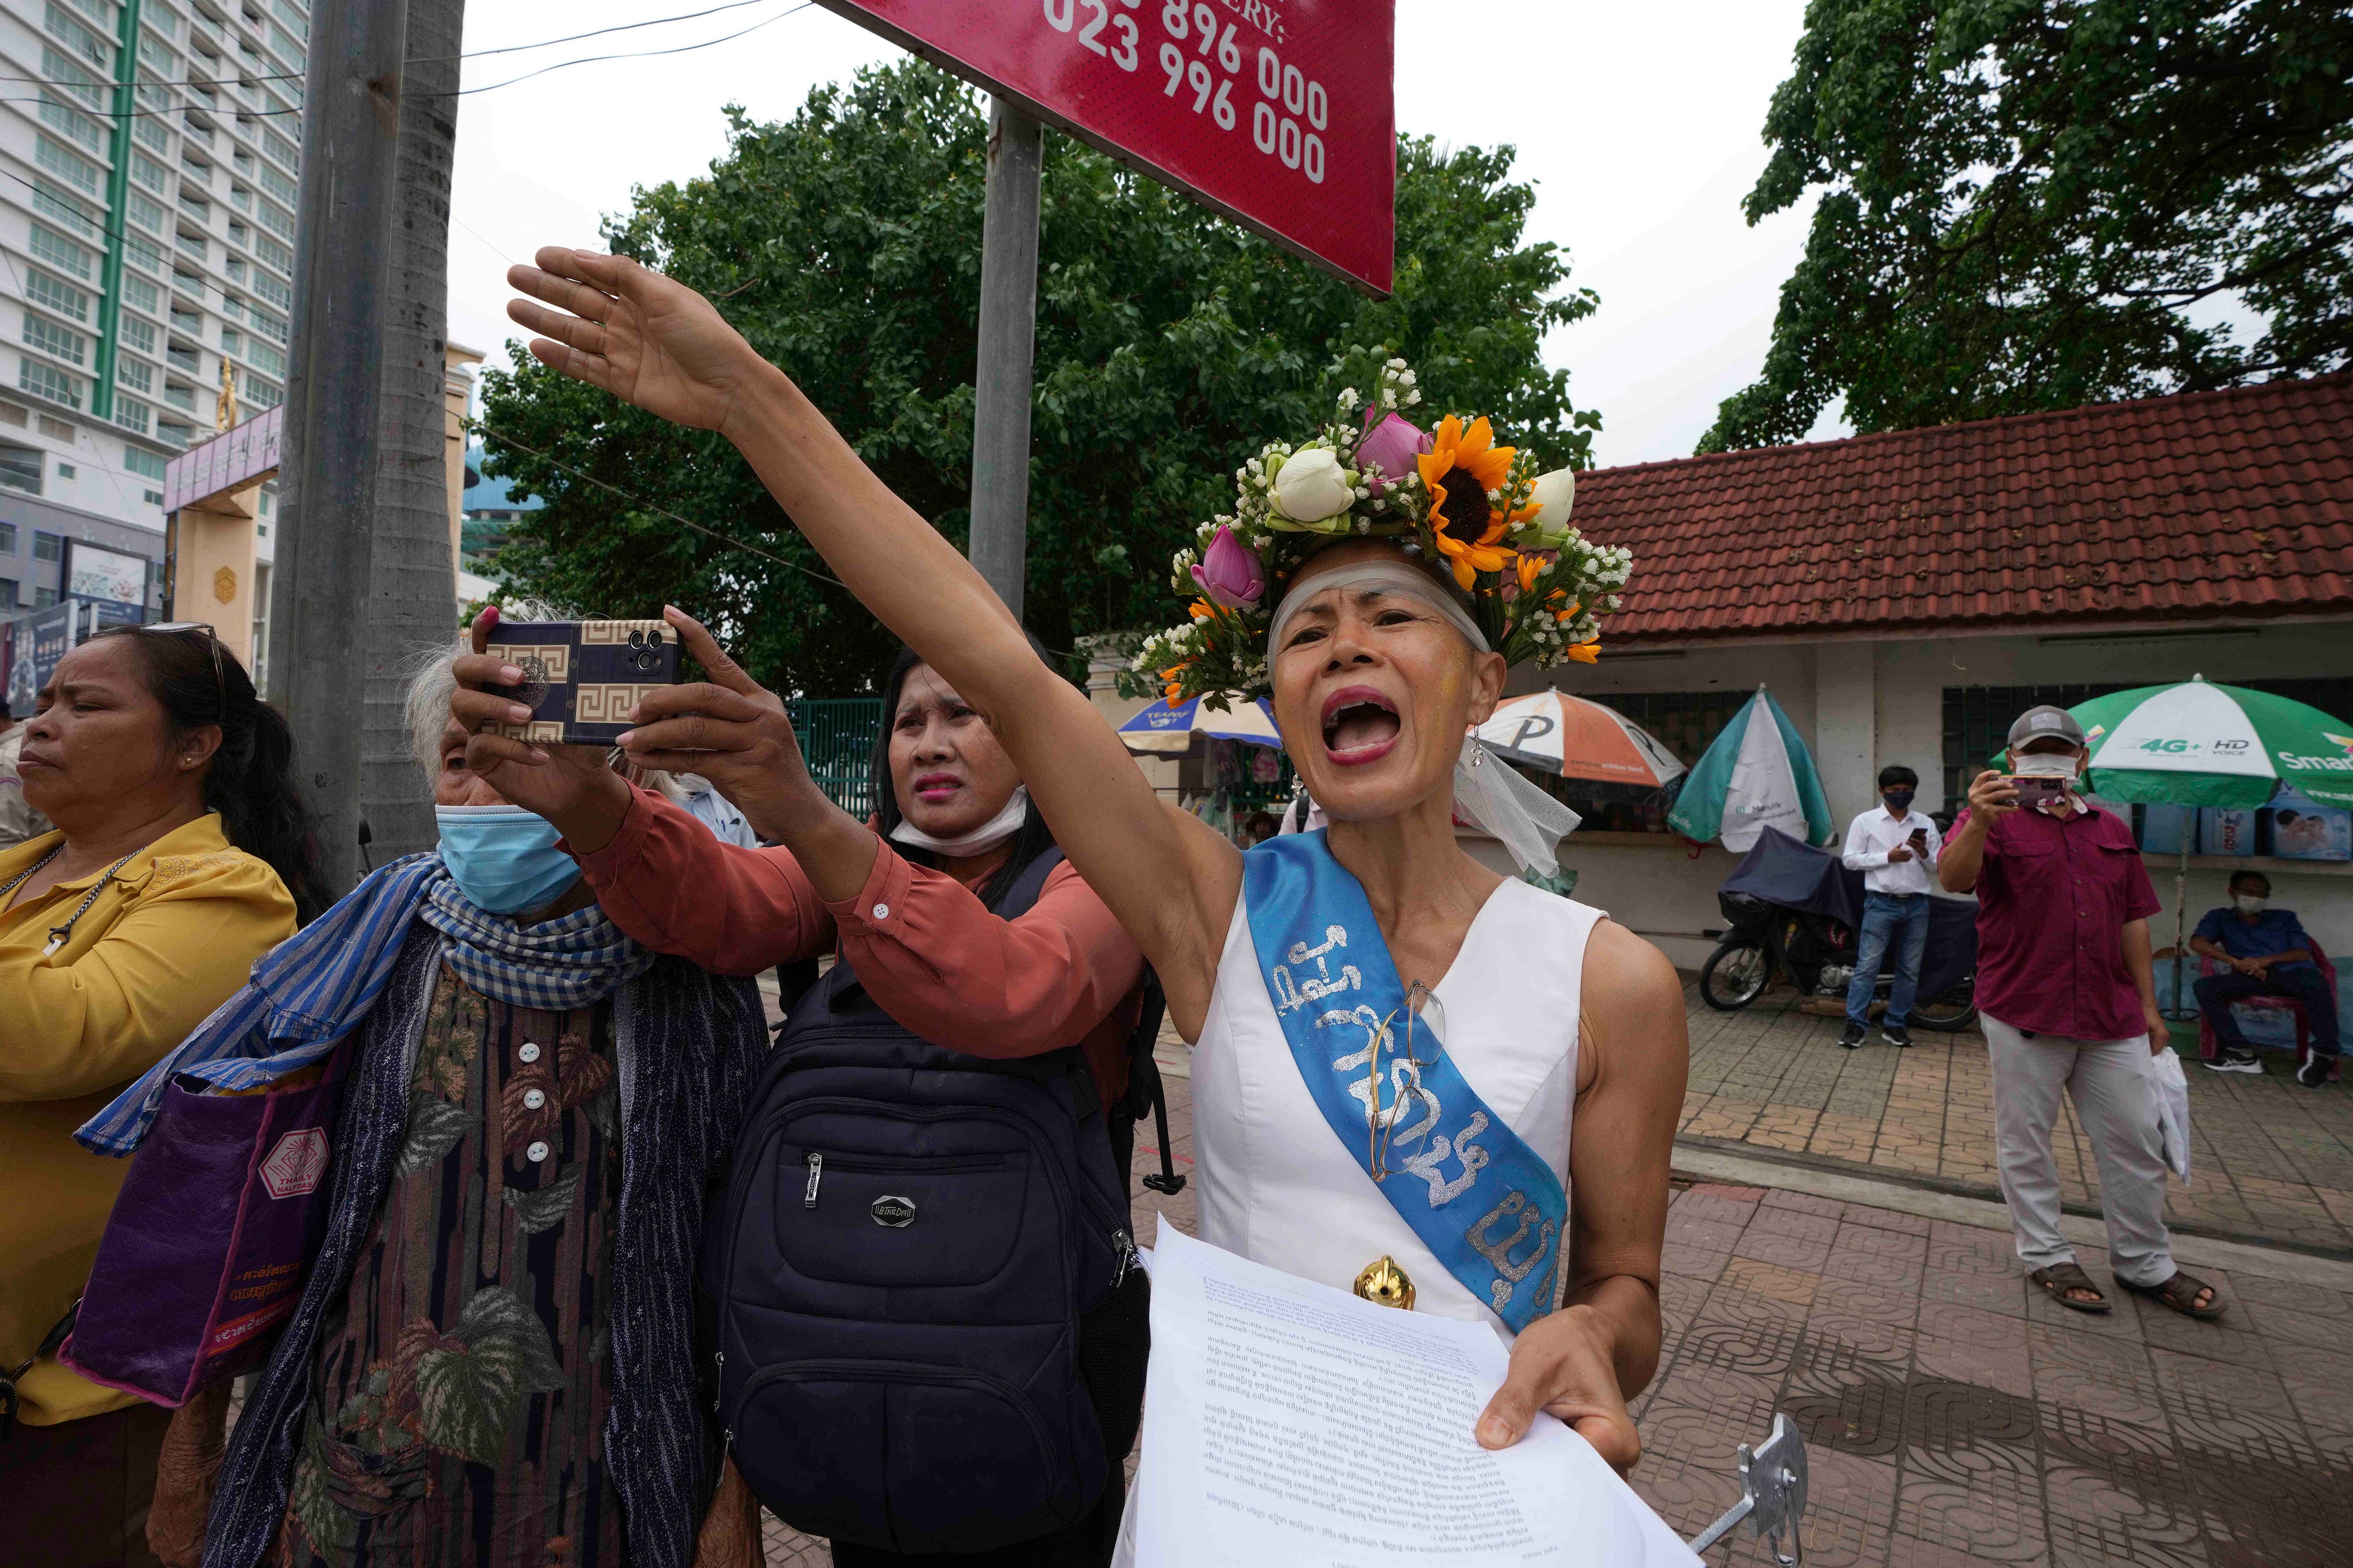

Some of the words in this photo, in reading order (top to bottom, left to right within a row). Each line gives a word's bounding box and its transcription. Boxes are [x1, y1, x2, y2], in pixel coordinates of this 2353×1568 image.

[1162, 0, 1241, 74] 896
[1258, 47, 1327, 131] 000
[1043, 0, 1139, 72] 023
[1159, 42, 1236, 130] 996
[1254, 102, 1325, 184] 000
[2214, 740, 2249, 749] HD
[2278, 751, 2353, 770] Smar
[1752, 801, 1781, 813] Manulife
[280, 1174, 313, 1185] THAILY
[277, 1182, 312, 1193] NALYDAS
